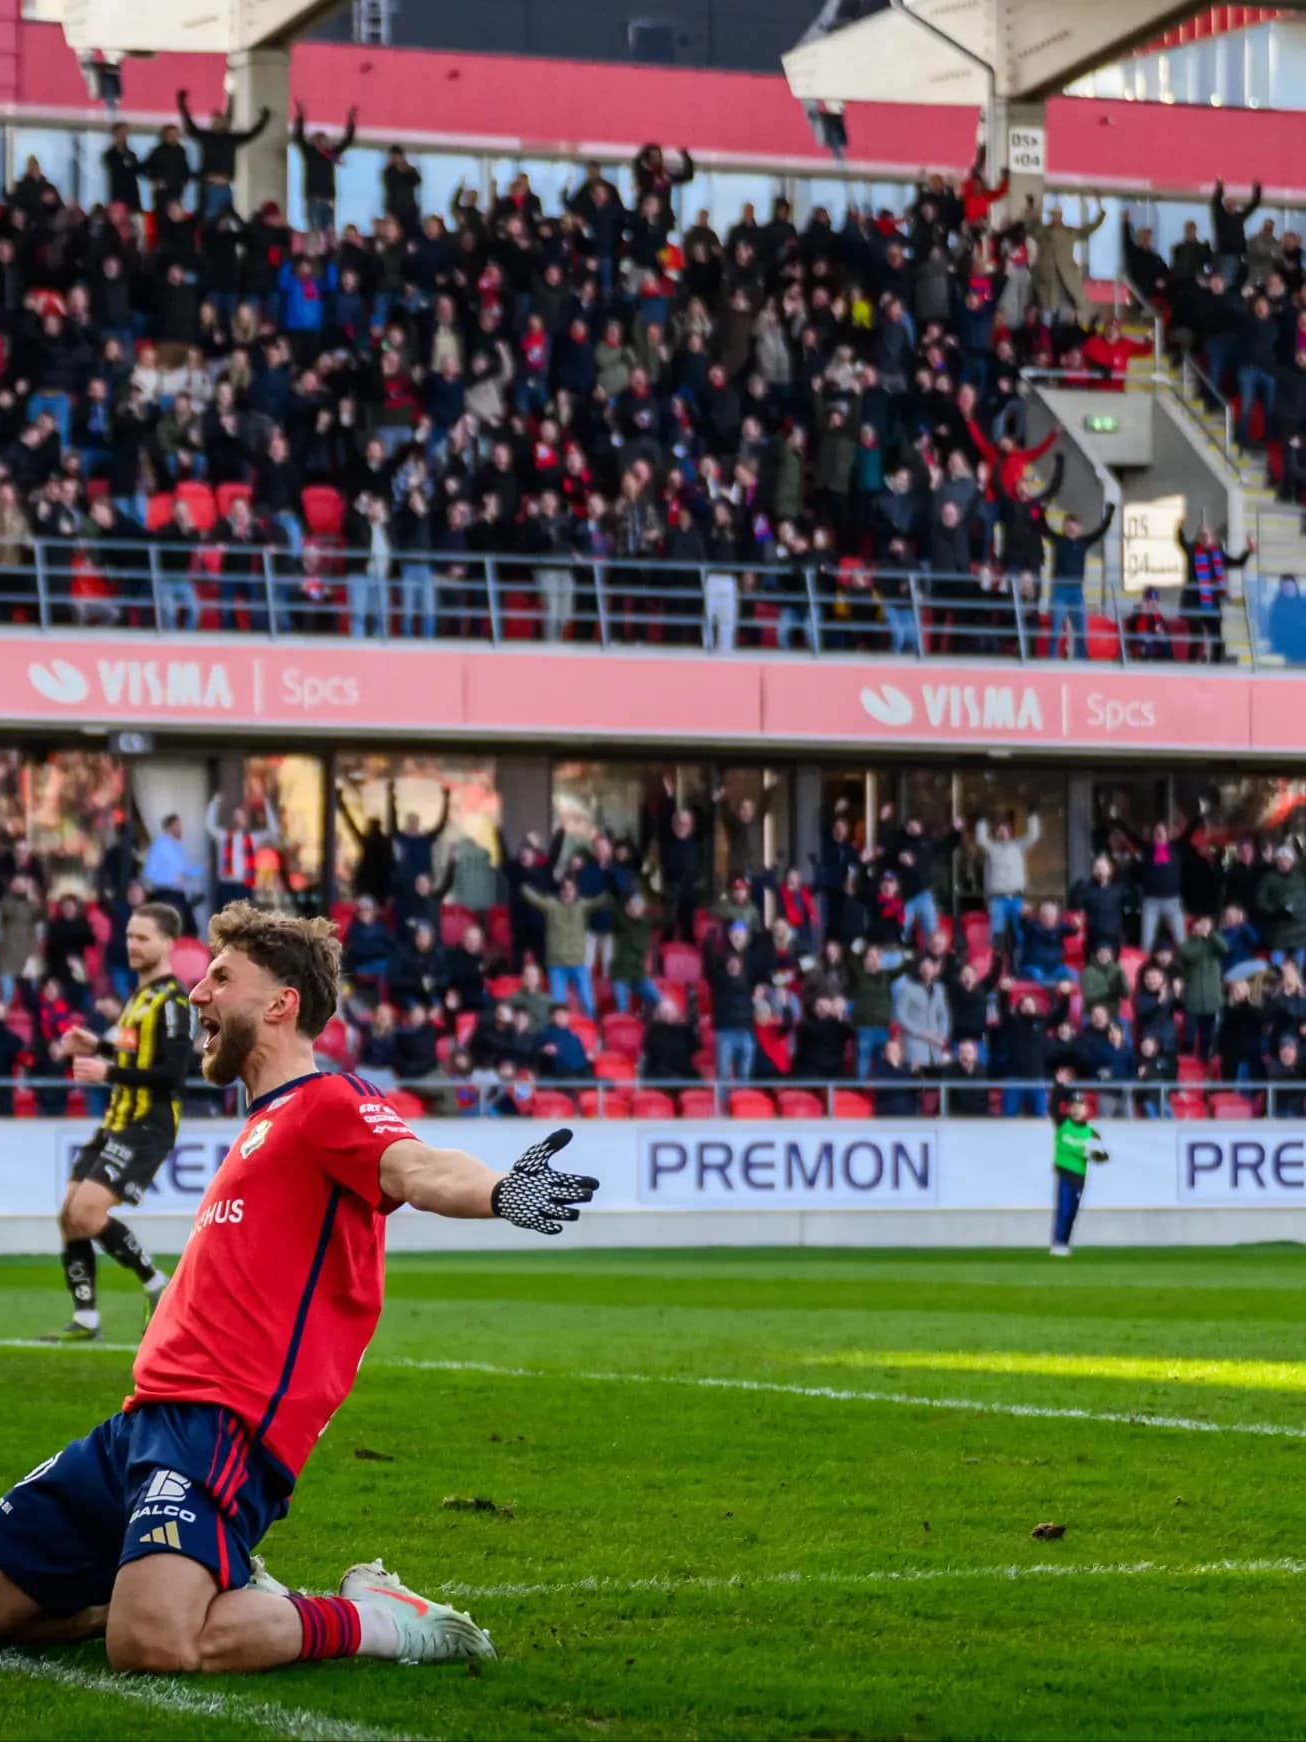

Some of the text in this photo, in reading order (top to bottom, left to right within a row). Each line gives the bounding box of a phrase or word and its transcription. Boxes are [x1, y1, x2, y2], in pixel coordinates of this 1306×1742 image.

[97, 659, 360, 711] VISMA Spcs
[920, 683, 1156, 734] VISMA Spcs
[648, 1140, 930, 1192] PREMON
[1187, 1141, 1304, 1189] PRE
